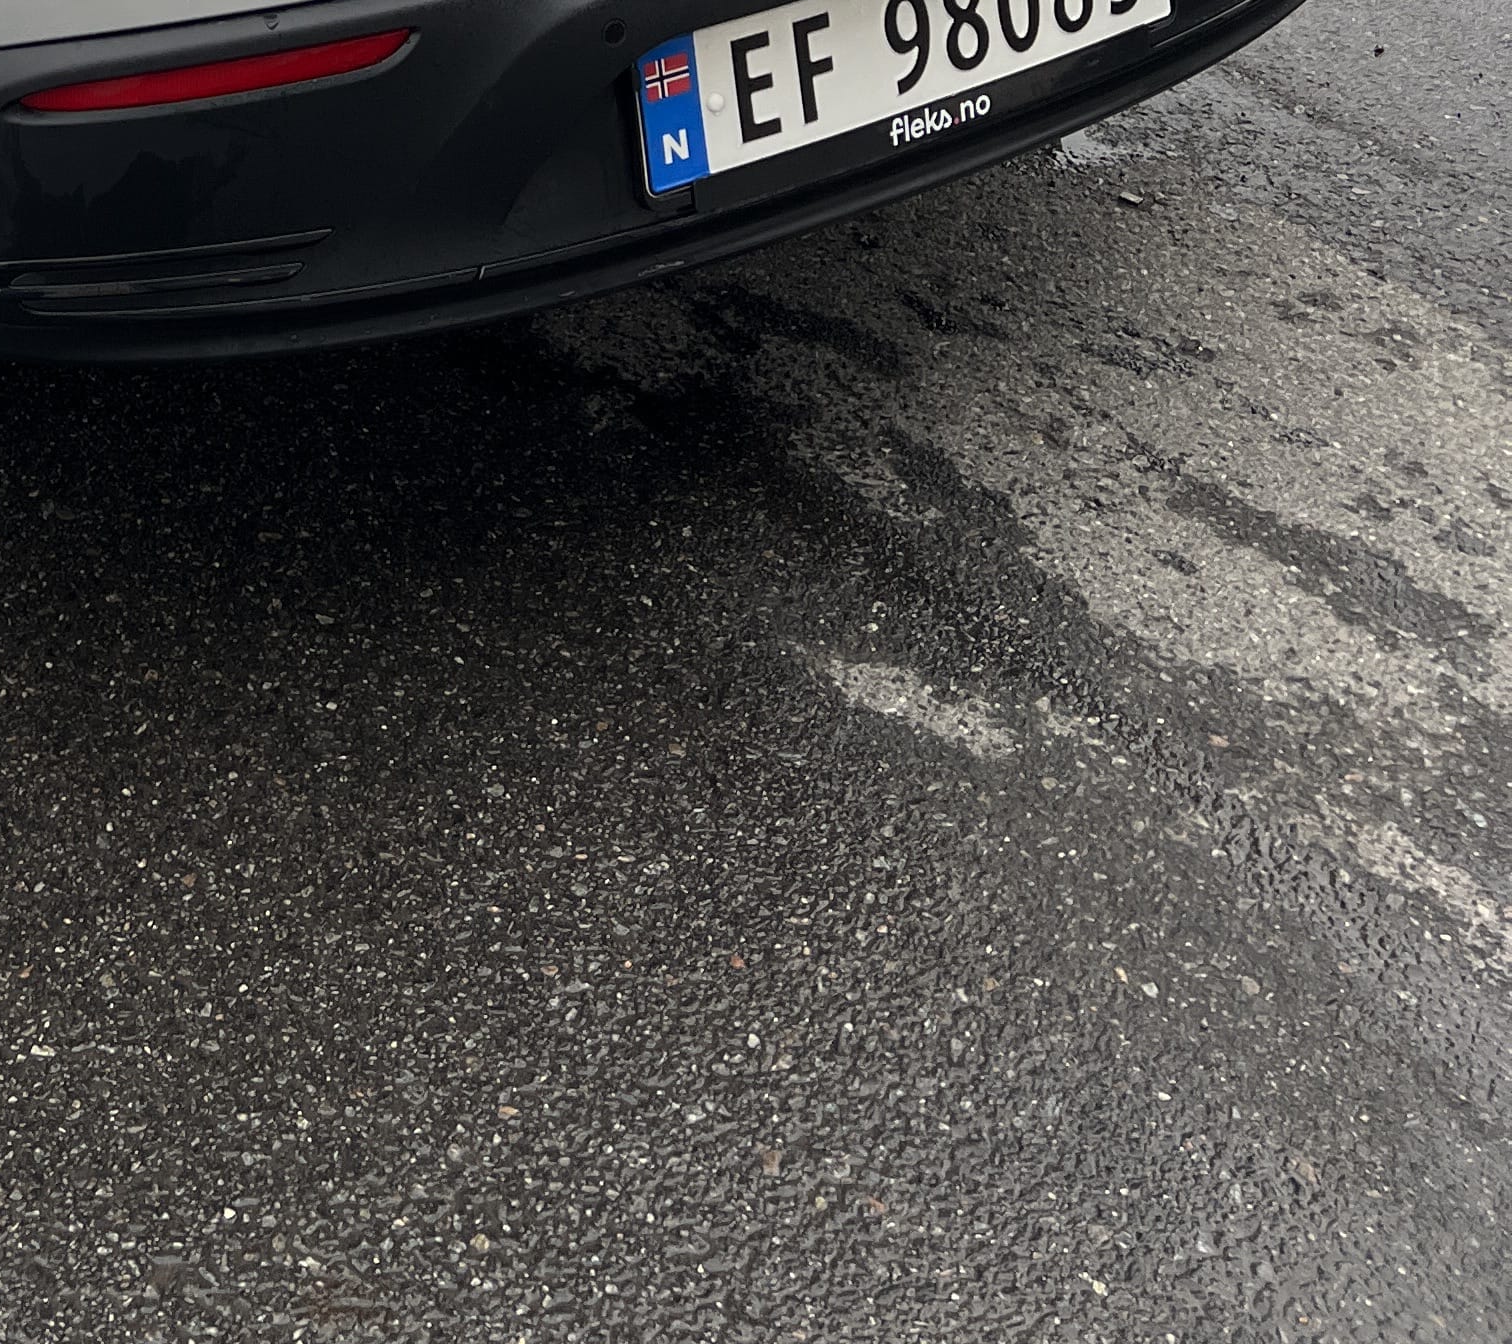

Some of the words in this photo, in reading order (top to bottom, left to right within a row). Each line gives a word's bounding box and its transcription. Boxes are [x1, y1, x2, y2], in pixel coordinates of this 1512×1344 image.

[728, 12, 835, 146] EF
[661, 127, 691, 167] N
[888, 93, 992, 149] fleks.no
